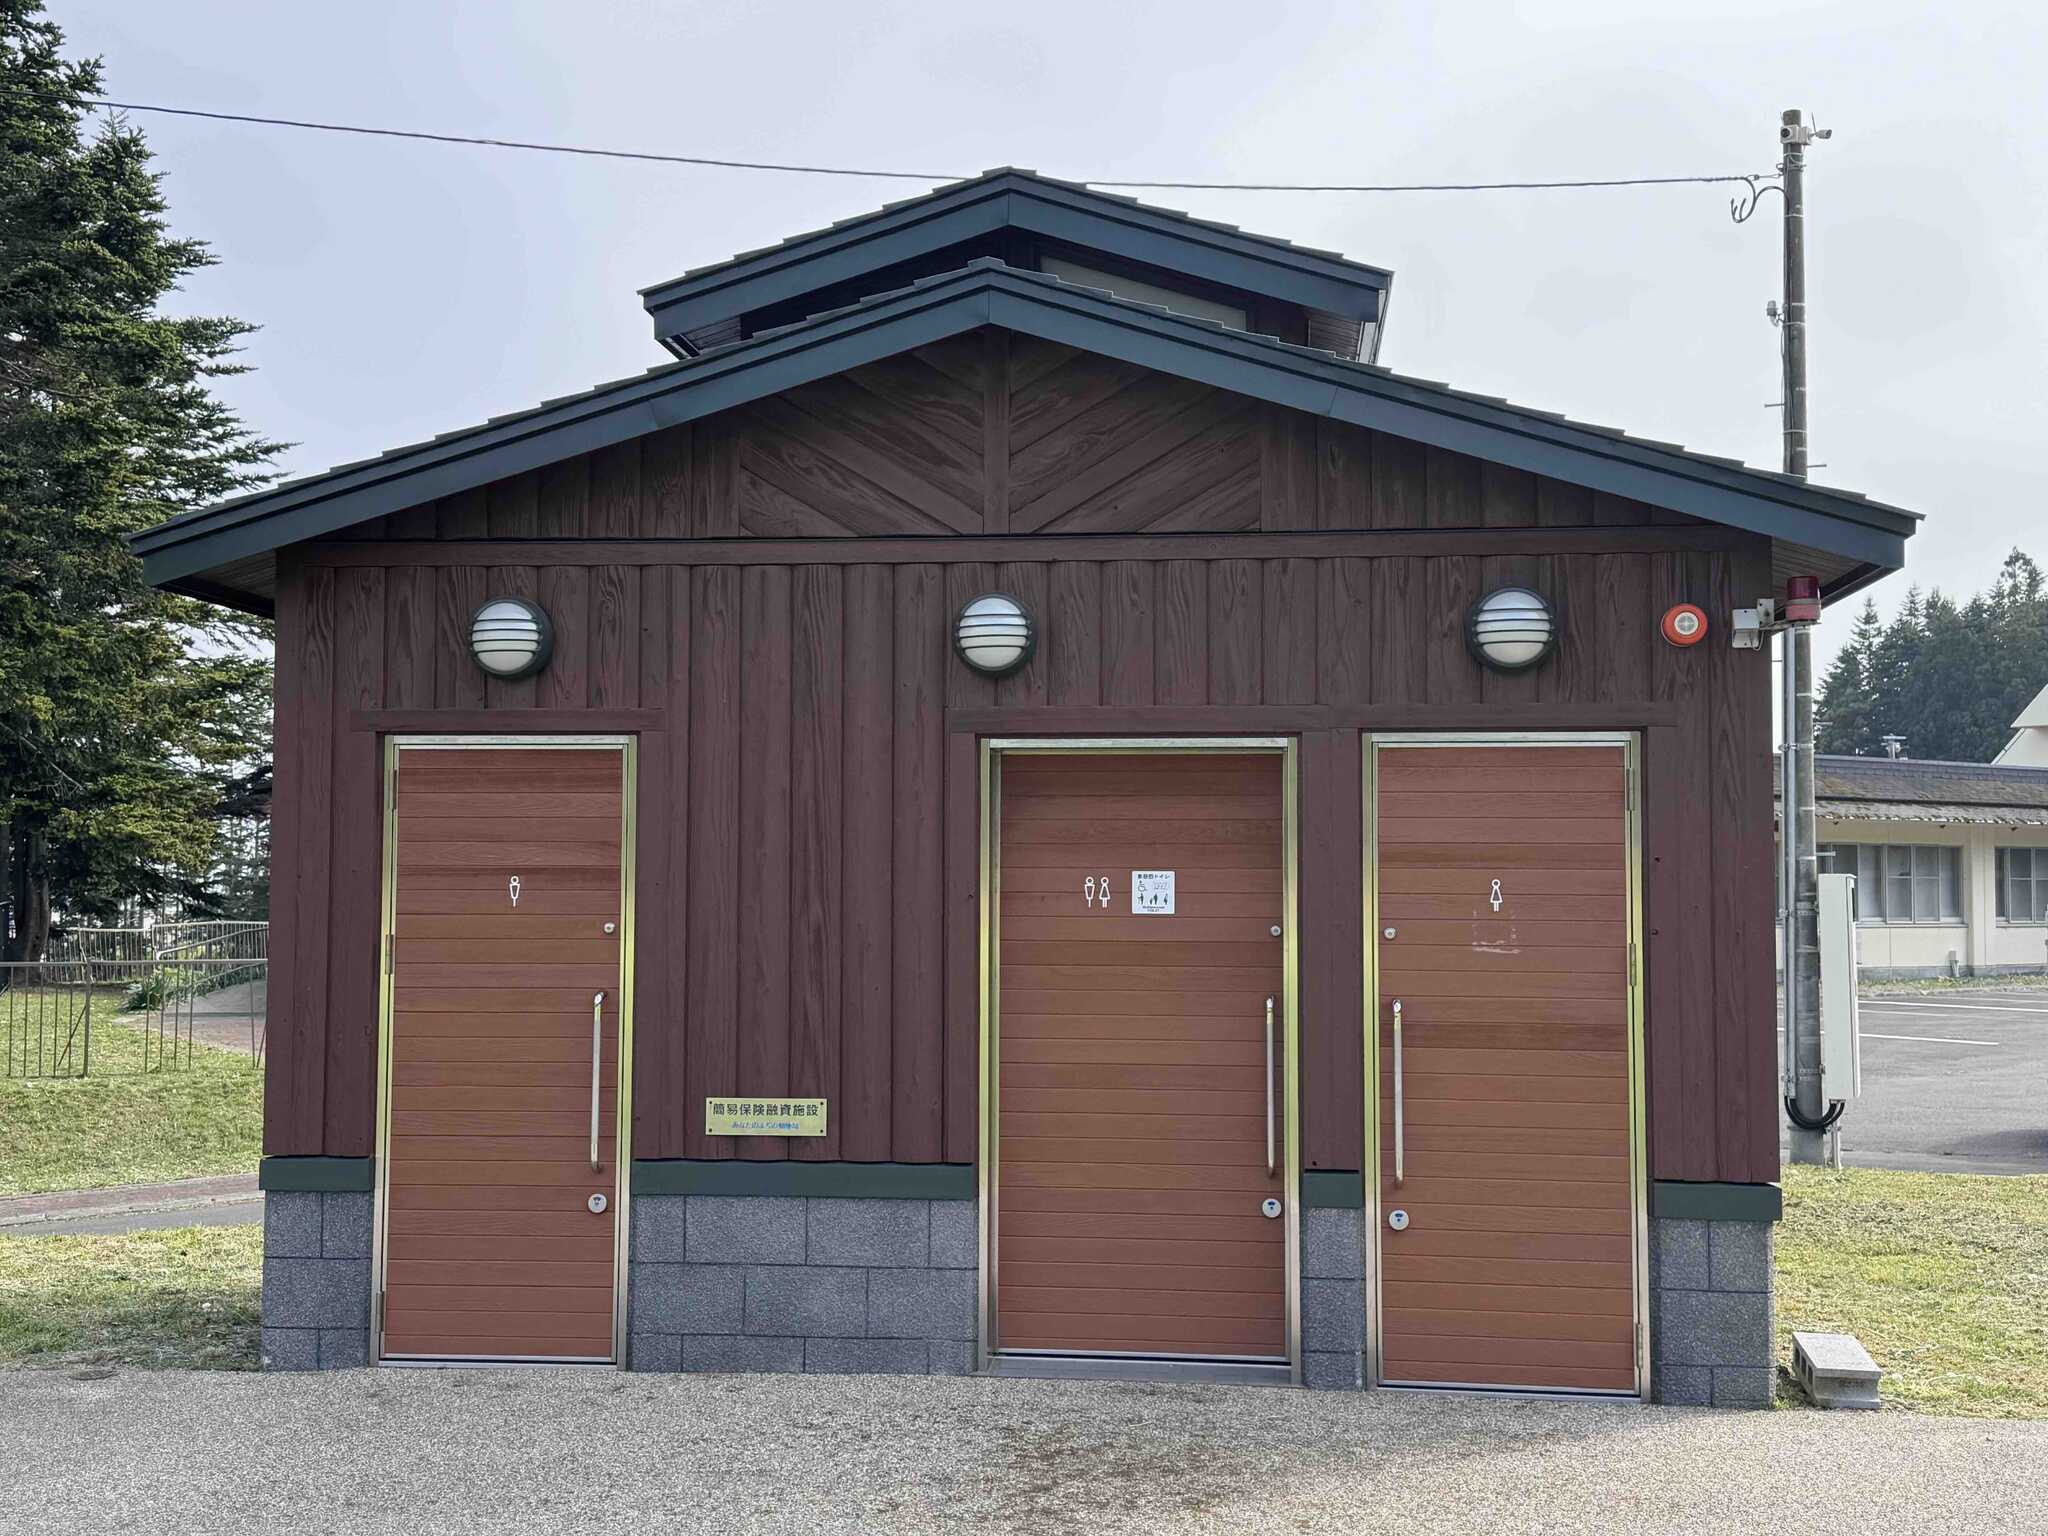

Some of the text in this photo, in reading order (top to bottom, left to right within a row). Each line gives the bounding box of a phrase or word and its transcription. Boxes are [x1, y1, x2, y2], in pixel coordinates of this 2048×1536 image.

[713, 1103, 819, 1117] 簡易保険融資施設
